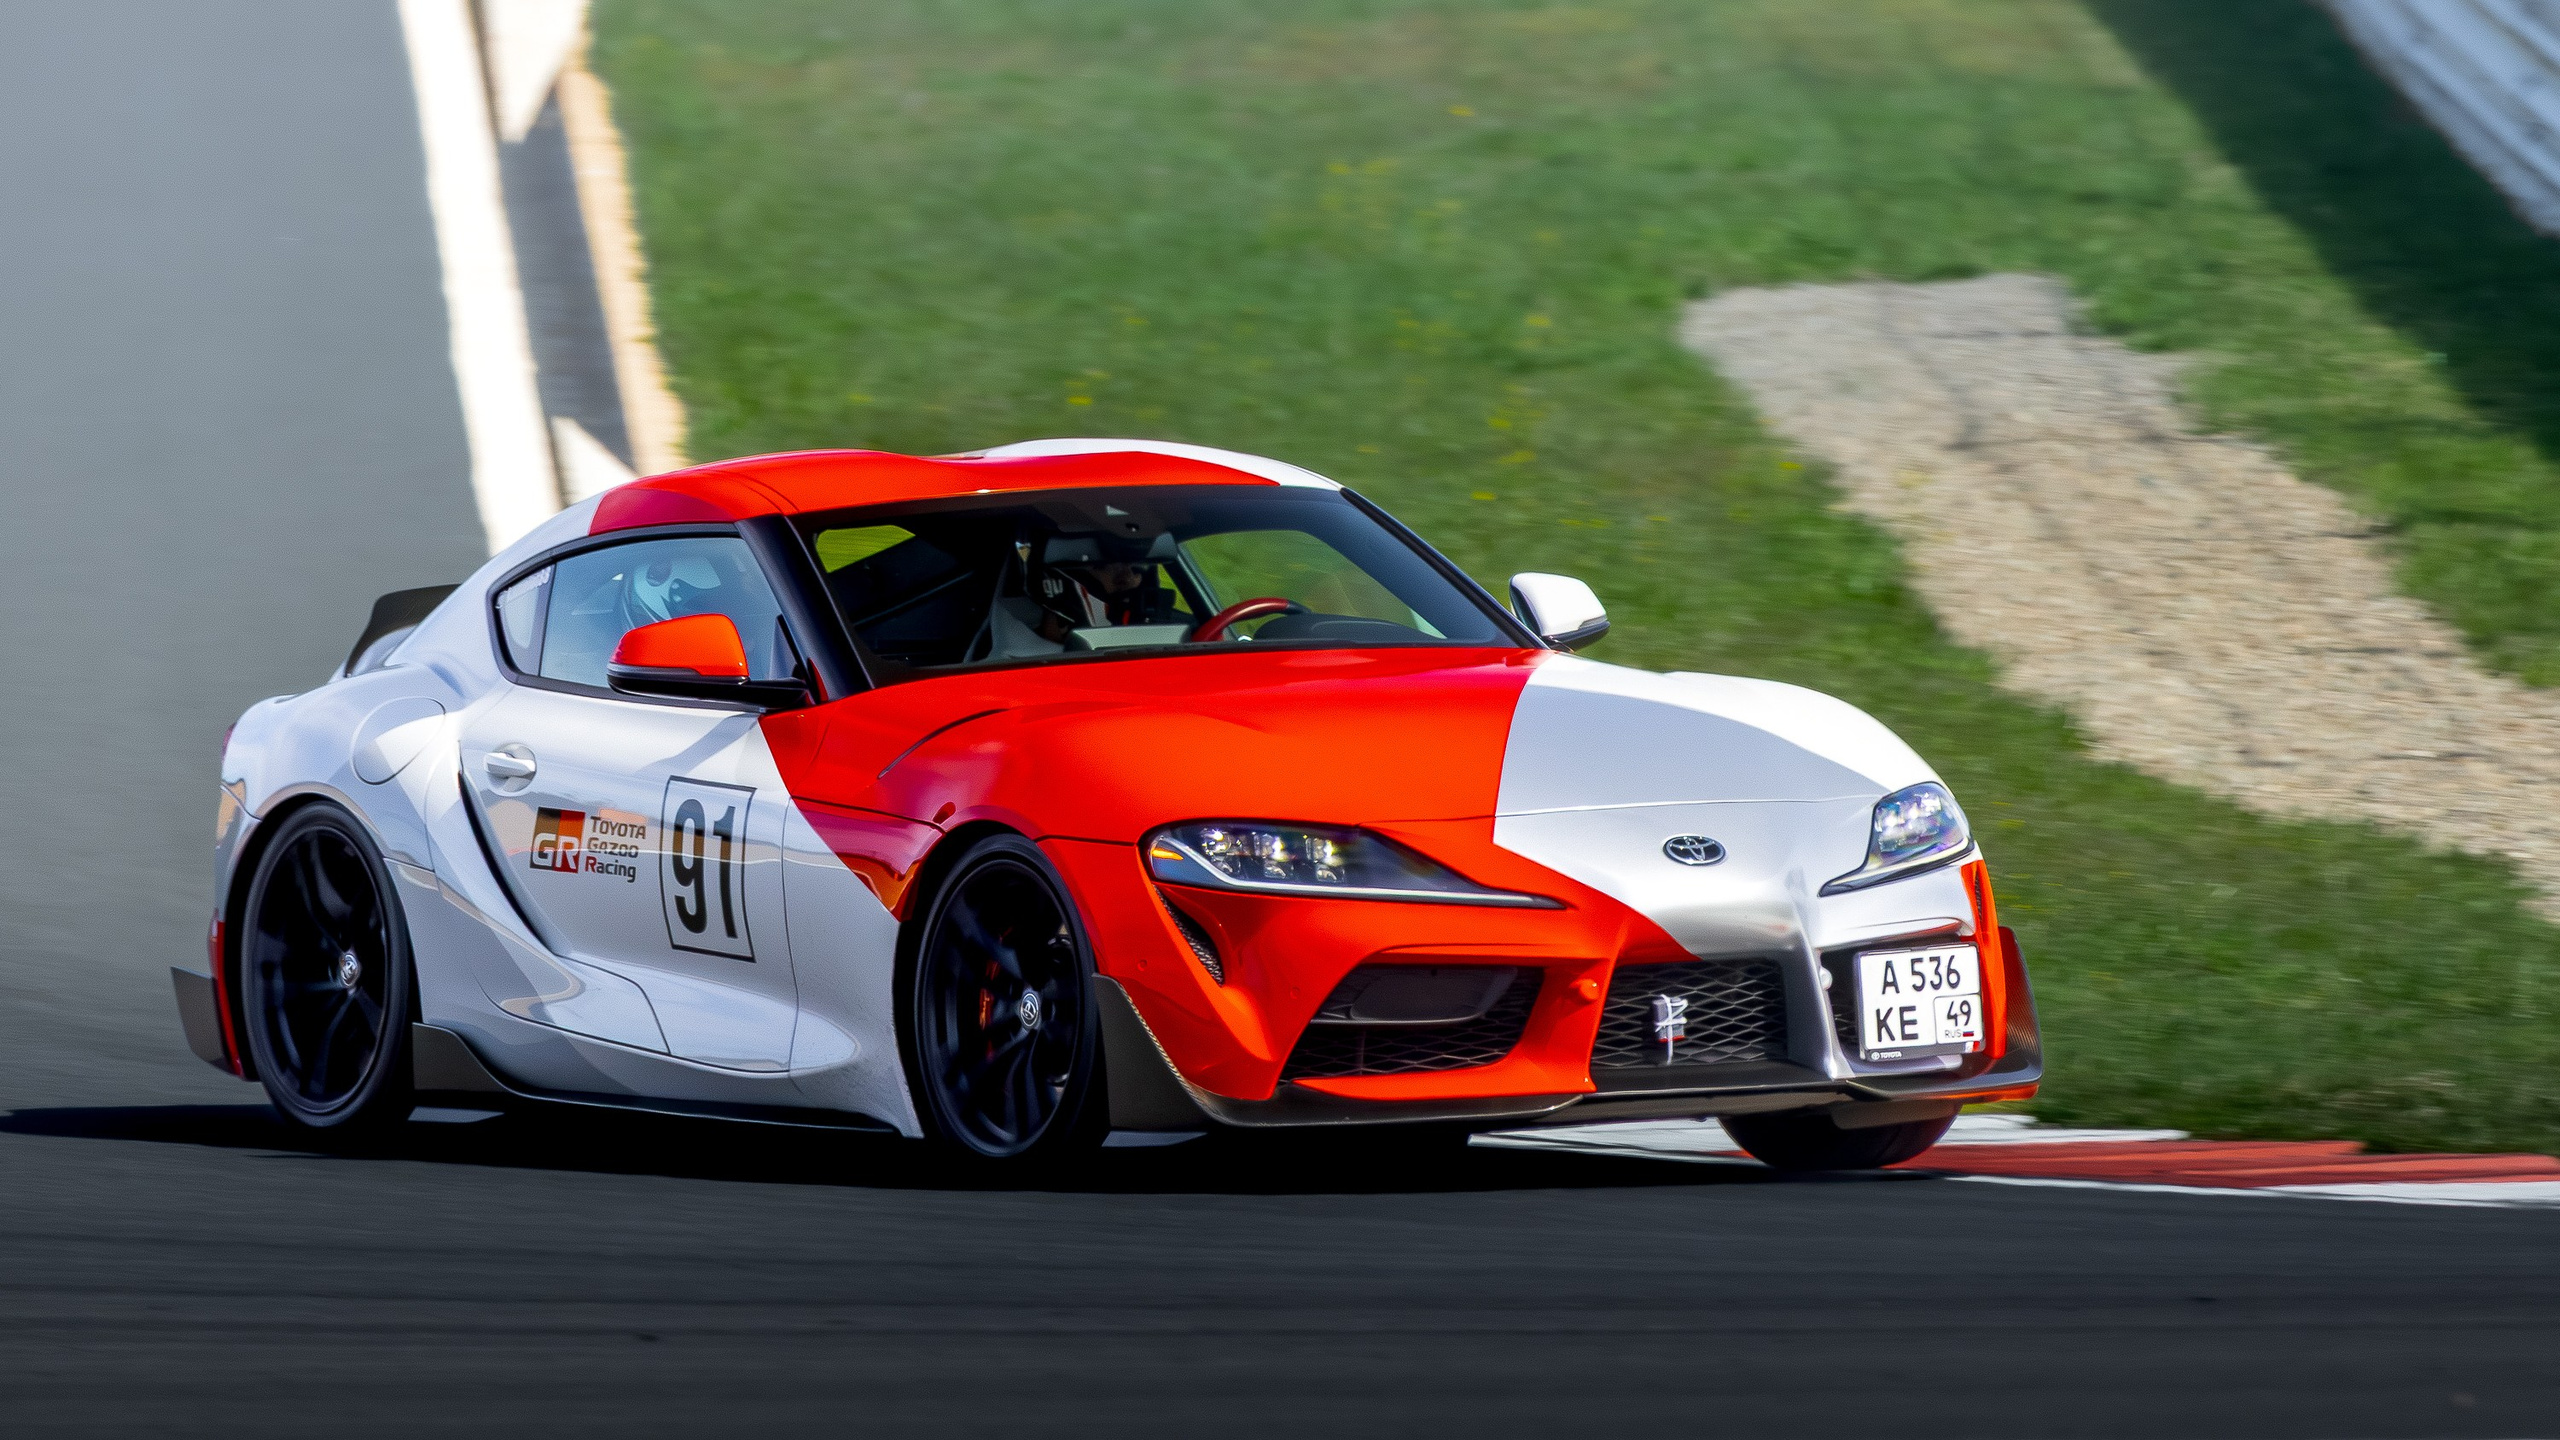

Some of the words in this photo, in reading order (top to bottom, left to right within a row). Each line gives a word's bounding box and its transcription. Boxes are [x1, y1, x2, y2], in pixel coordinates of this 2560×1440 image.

[590, 815, 646, 839] TOYOTA
[532, 832, 580, 870] GR
[587, 837, 639, 858] GAZOO
[585, 855, 636, 883] Racing
[672, 798, 738, 939] 91
[1910, 954, 1961, 992] 536
[1946, 999, 1972, 1027] 49
[1944, 1029, 1962, 1039] RUS
[1880, 1051, 1902, 1059] TOYOTA
